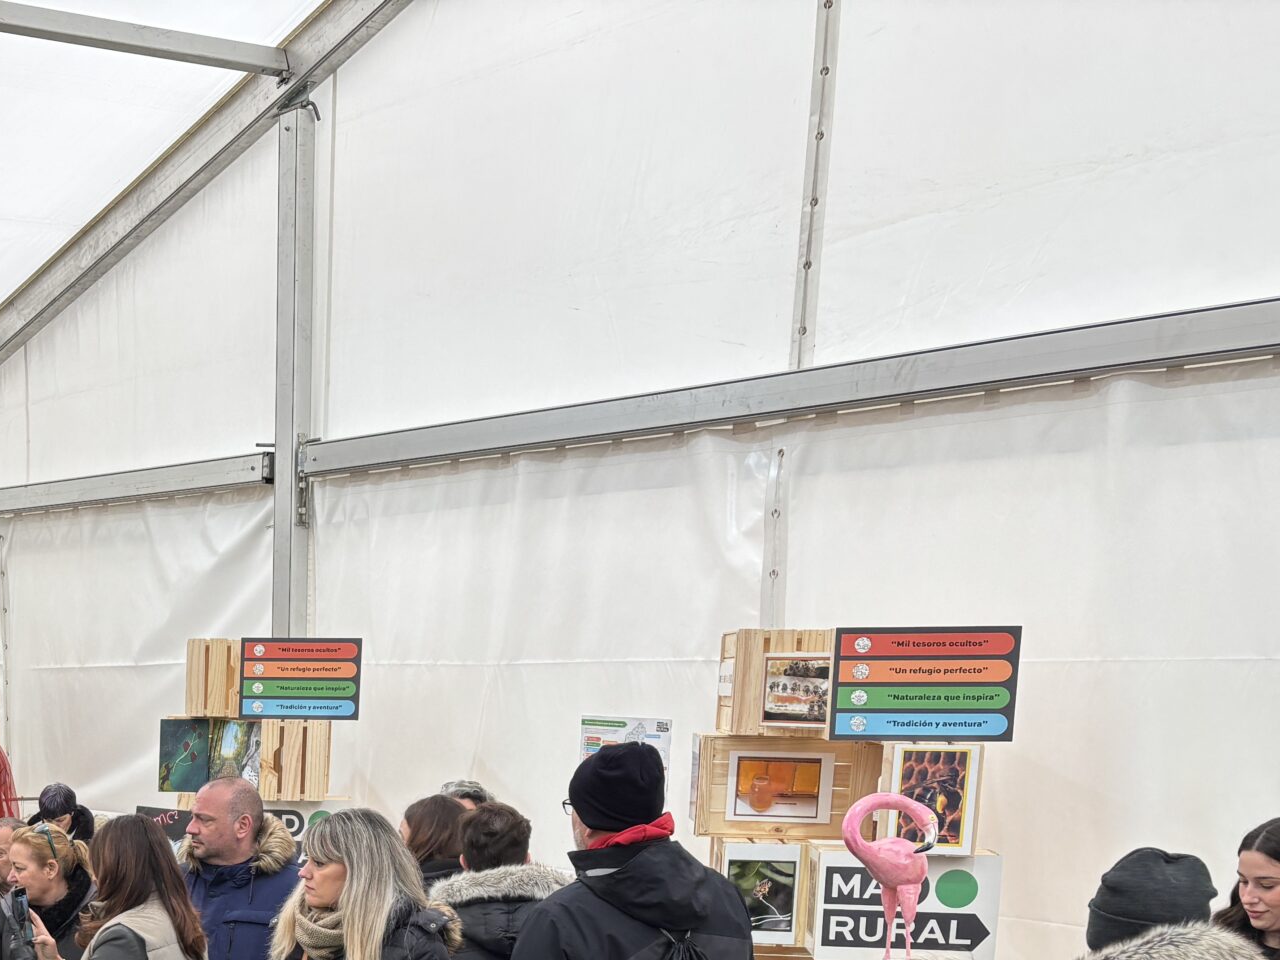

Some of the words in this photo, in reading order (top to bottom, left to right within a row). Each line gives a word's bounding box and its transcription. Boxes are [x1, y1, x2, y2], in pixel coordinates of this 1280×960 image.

[909, 666, 941, 675] refugio
[935, 721, 941, 729] y
[829, 916, 972, 945] RURAL
